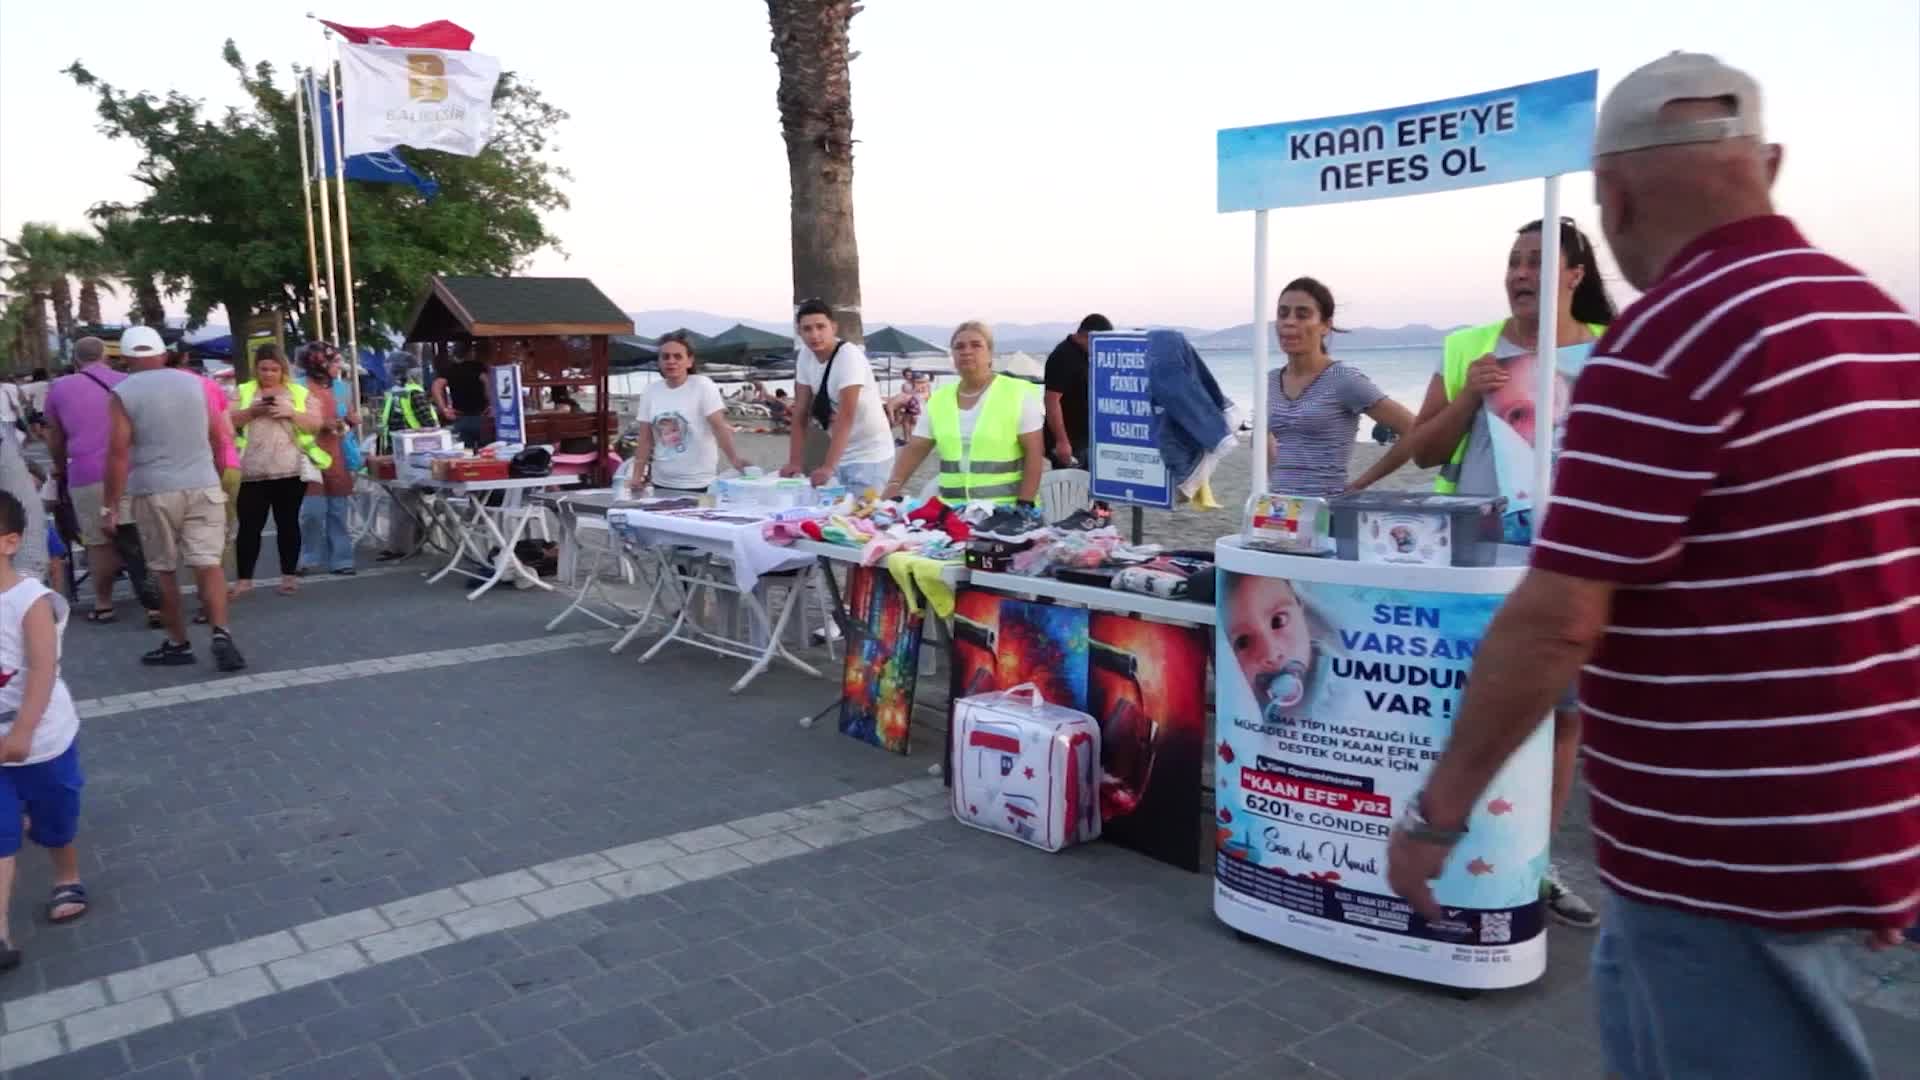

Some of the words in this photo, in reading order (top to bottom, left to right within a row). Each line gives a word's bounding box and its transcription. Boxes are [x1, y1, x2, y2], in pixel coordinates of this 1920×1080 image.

[1290, 125, 1384, 160] KAAN
[1397, 101, 1515, 148] EFE'YE
[1321, 154, 1428, 191] NEFES
[1442, 147, 1486, 176] OL
[1117, 347, 1148, 371] İÇERİS
[1140, 375, 1151, 393] V
[1372, 604, 1440, 629] SEN
[1339, 629, 1474, 660] VARSAN
[1364, 690, 1433, 717] VAR
[1234, 718, 1299, 741] MÜCADELE
[1302, 732, 1338, 748] EDEN
[1343, 739, 1383, 754] KAAN
[1388, 744, 1417, 759] EFE
[1419, 750, 1442, 761] BE
[1269, 713, 1296, 727] SMA
[1330, 724, 1405, 744] HASTALIĞI
[1409, 733, 1433, 748] İLE
[1278, 740, 1328, 760] DESTEK
[1332, 750, 1384, 767] OLMAK
[1388, 755, 1419, 773] İÇİN
[1352, 798, 1389, 814] yaz
[1309, 811, 1390, 837] GÖNDER
[1264, 826, 1292, 857] Sen
[1297, 840, 1313, 862] de
[1319, 841, 1379, 875] Umut
